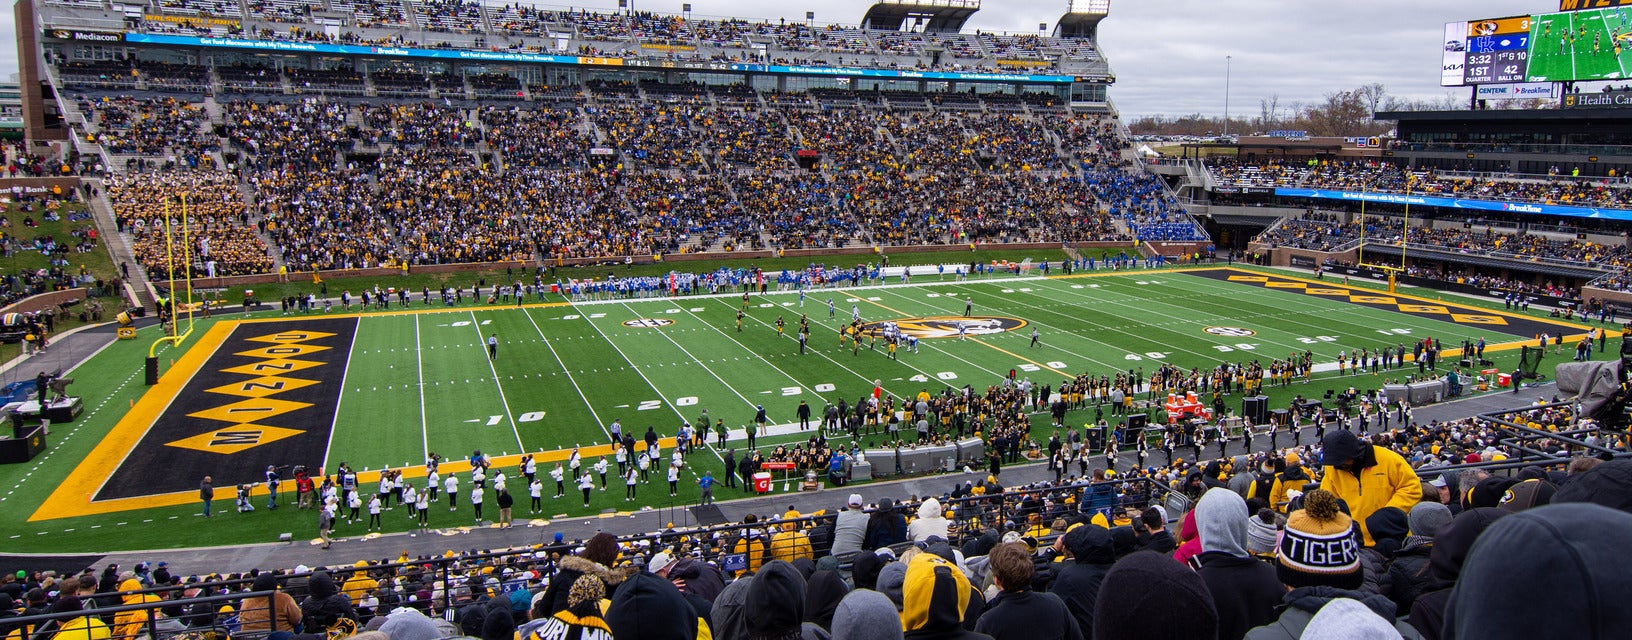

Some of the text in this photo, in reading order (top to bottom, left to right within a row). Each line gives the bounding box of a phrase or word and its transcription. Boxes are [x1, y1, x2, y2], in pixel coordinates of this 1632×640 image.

[1520, 20, 1528, 29] 3
[75, 33, 118, 42] Mediacom
[1520, 37, 1527, 46] 7
[225, 39, 253, 47] discounts
[268, 42, 291, 50] MyTime
[1469, 55, 1491, 65] 3:32
[1517, 52, 1526, 60] 10
[1469, 66, 1489, 76] 1ST
[1504, 65, 1518, 74] 42
[1521, 87, 1551, 95] BreakTime
[1578, 94, 1612, 105] Health
[1359, 193, 1378, 201] dscounts
[1508, 203, 1542, 213] BreakTime
[207, 333, 308, 447] MIZZOU
[759, 480, 768, 489] G
[1286, 533, 1358, 565] TIGERS
